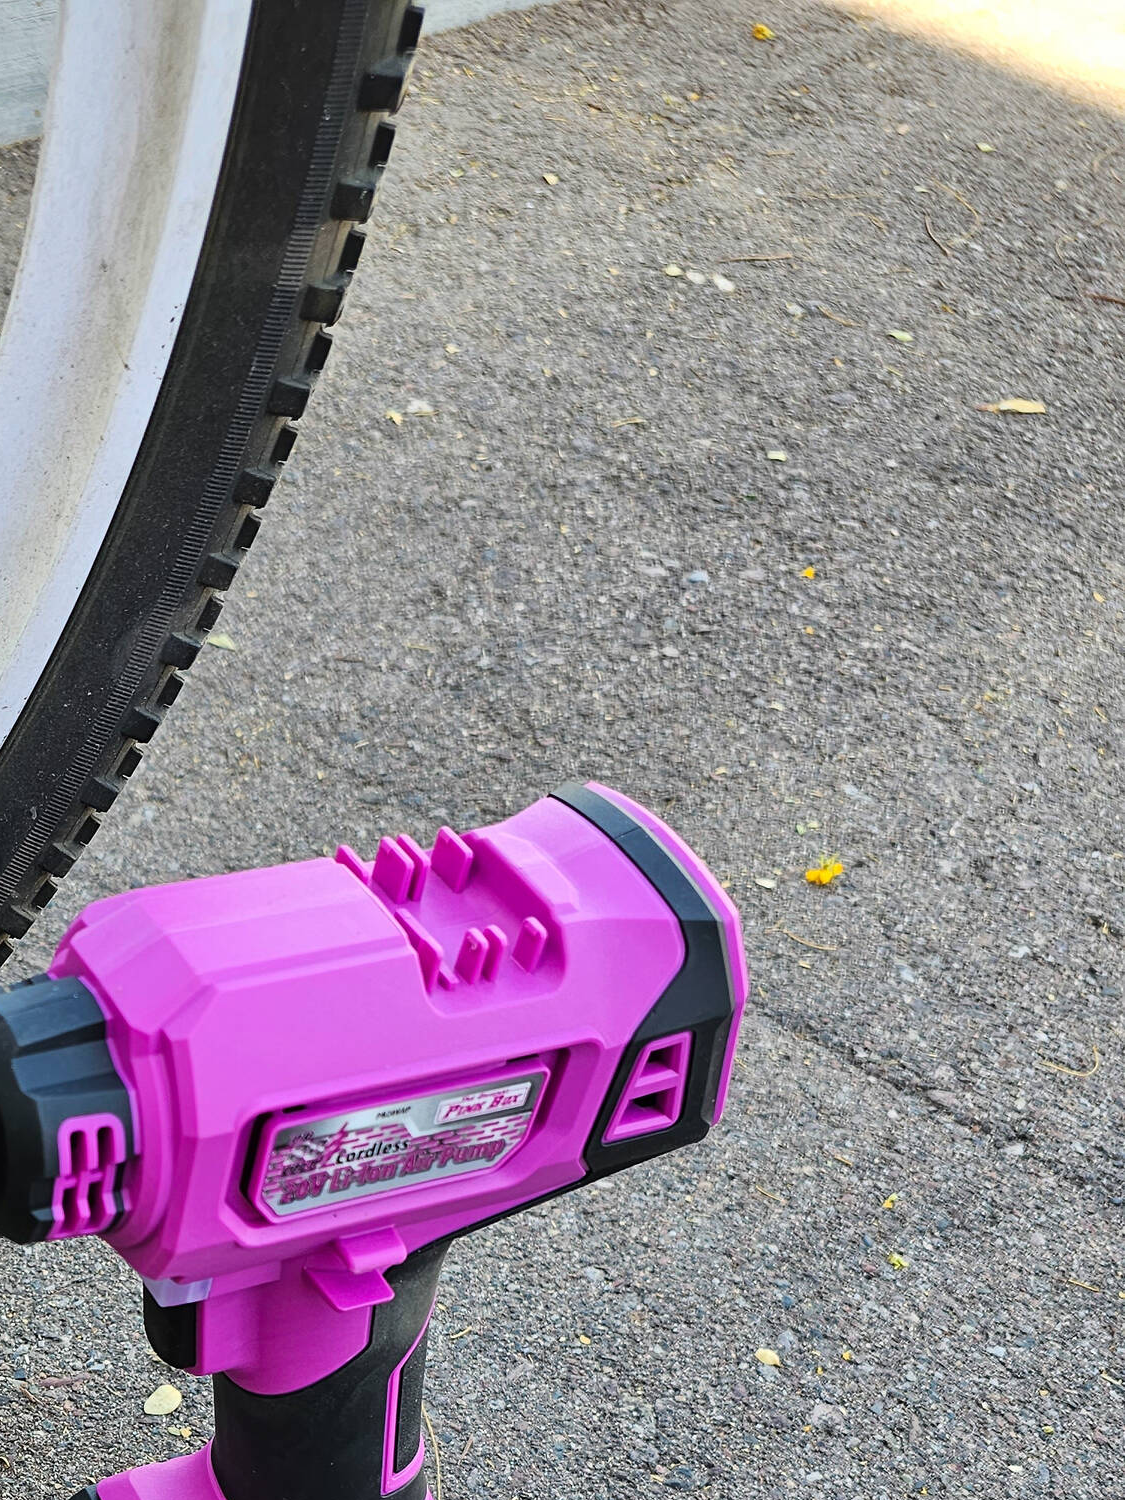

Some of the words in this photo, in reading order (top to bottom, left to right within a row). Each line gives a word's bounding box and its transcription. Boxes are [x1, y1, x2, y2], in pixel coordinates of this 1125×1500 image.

[336, 1138, 411, 1164] Cordless
[401, 1147, 439, 1177] Air
[437, 1139, 506, 1167] Pump
